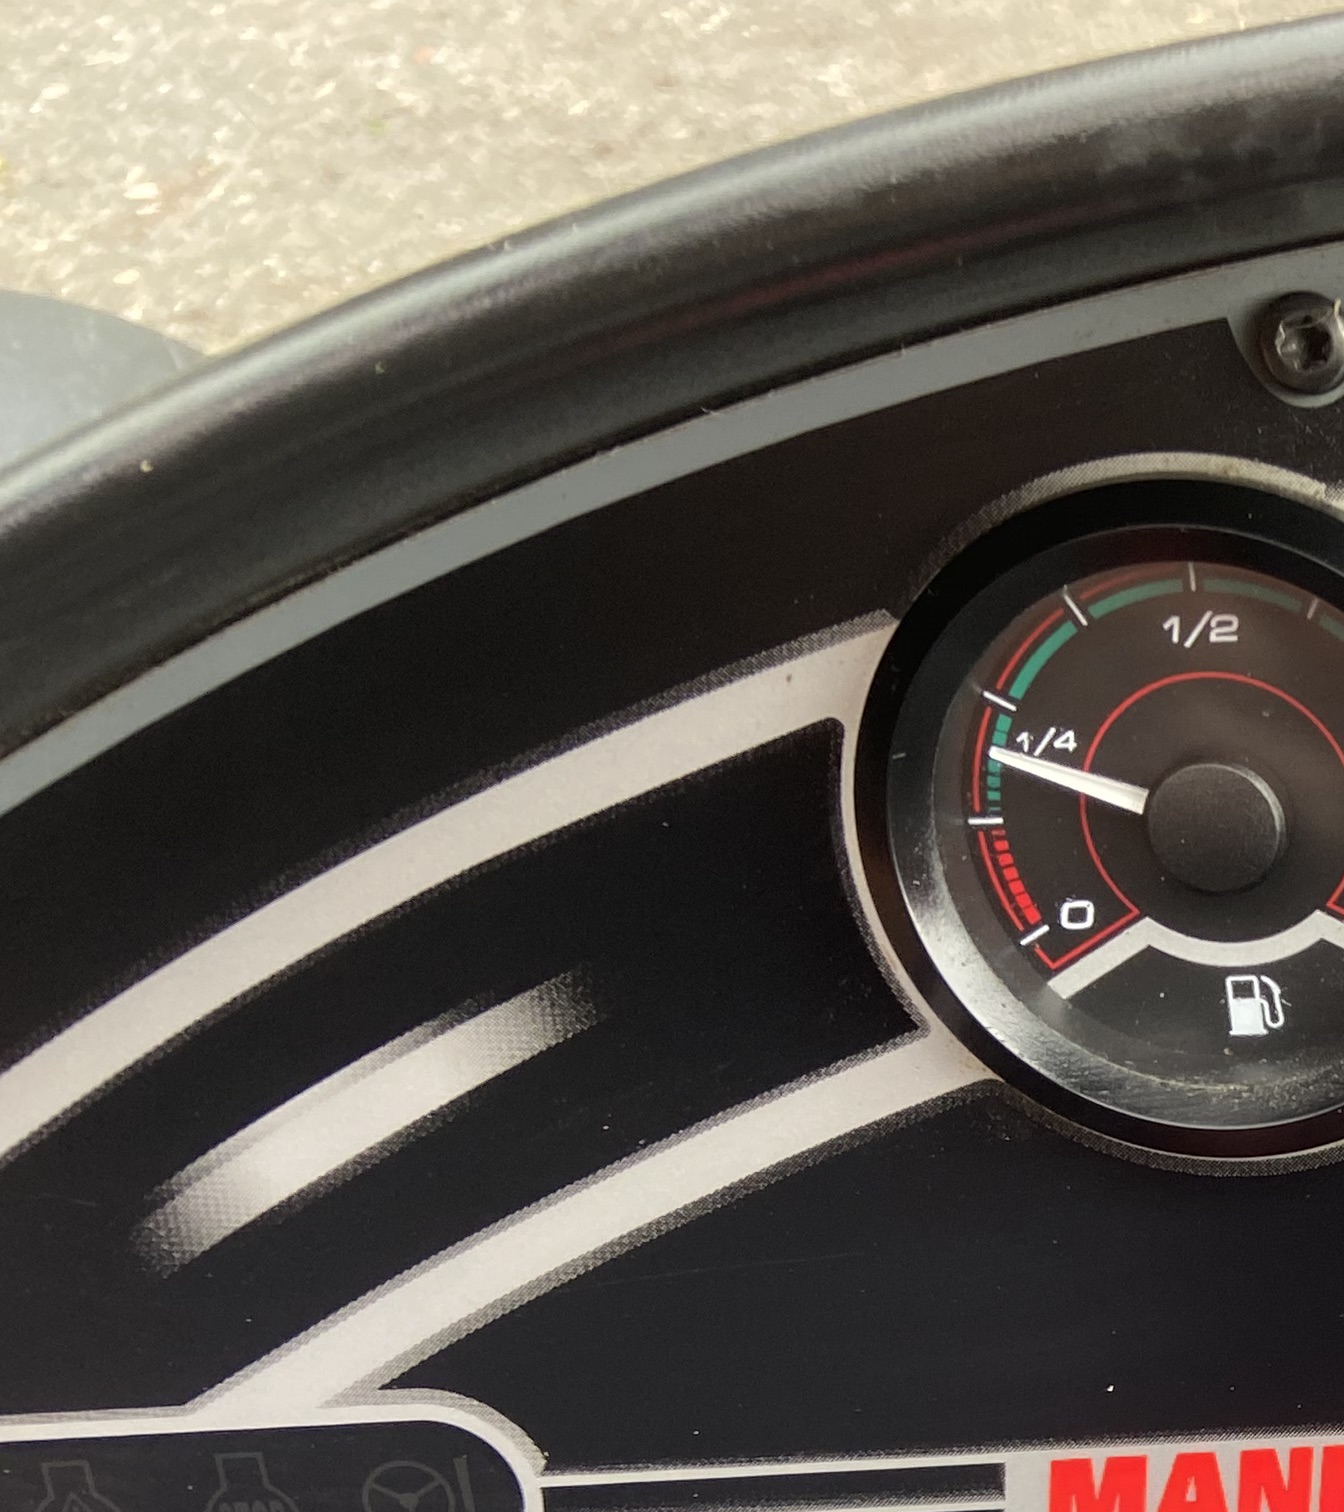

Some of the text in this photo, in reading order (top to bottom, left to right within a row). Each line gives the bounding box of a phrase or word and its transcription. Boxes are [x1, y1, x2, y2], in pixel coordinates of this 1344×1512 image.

[1161, 611, 1240, 648] 1/2
[1015, 728, 1078, 757] 1/4
[1059, 900, 1095, 929] 0
